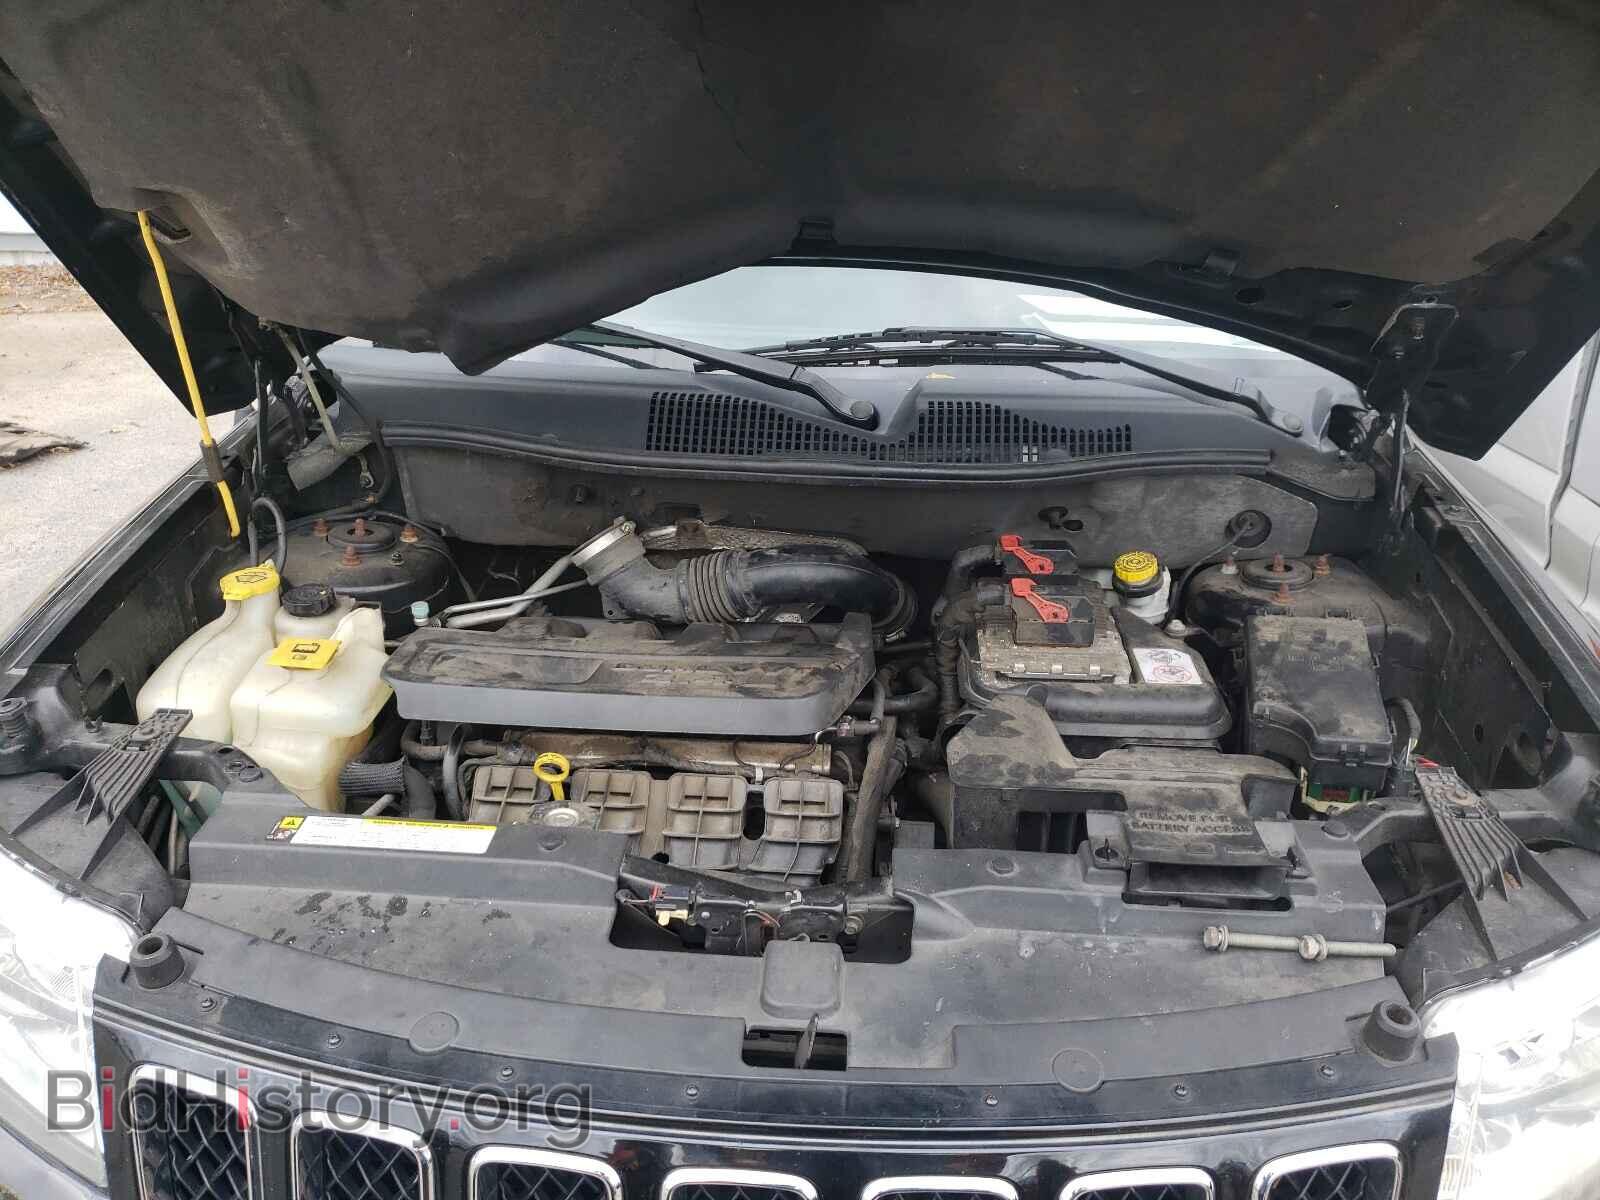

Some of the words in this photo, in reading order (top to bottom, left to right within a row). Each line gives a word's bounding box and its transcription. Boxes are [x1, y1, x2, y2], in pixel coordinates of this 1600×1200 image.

[1138, 813, 1197, 823] REMOVE
[1200, 815, 1233, 824] FOR
[1132, 823, 1190, 833] BATTERY
[1195, 824, 1253, 834] ACCESS
